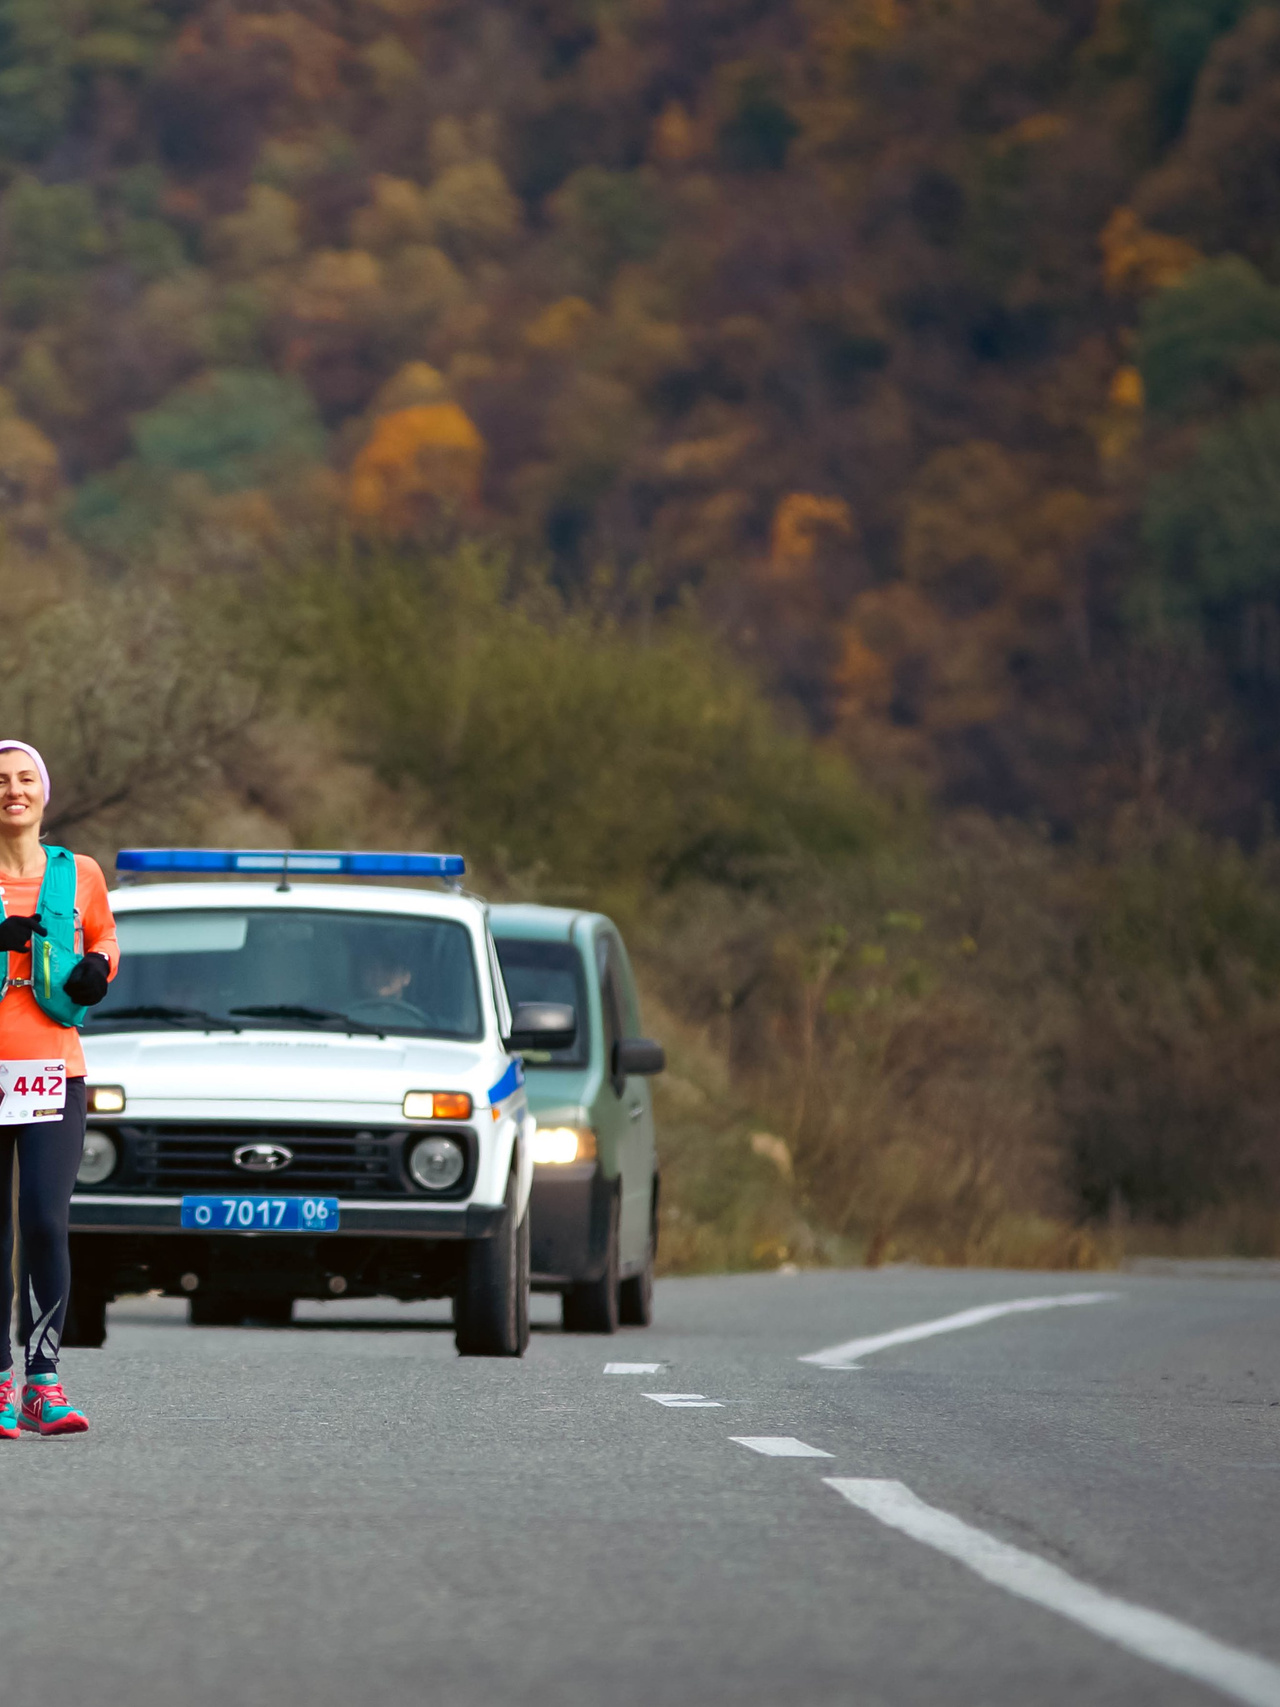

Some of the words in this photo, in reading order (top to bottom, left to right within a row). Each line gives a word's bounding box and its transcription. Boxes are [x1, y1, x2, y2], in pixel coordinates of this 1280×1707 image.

[13, 1076, 63, 1096] 442
[221, 1200, 287, 1226] 7017
[302, 1199, 329, 1220] 06
